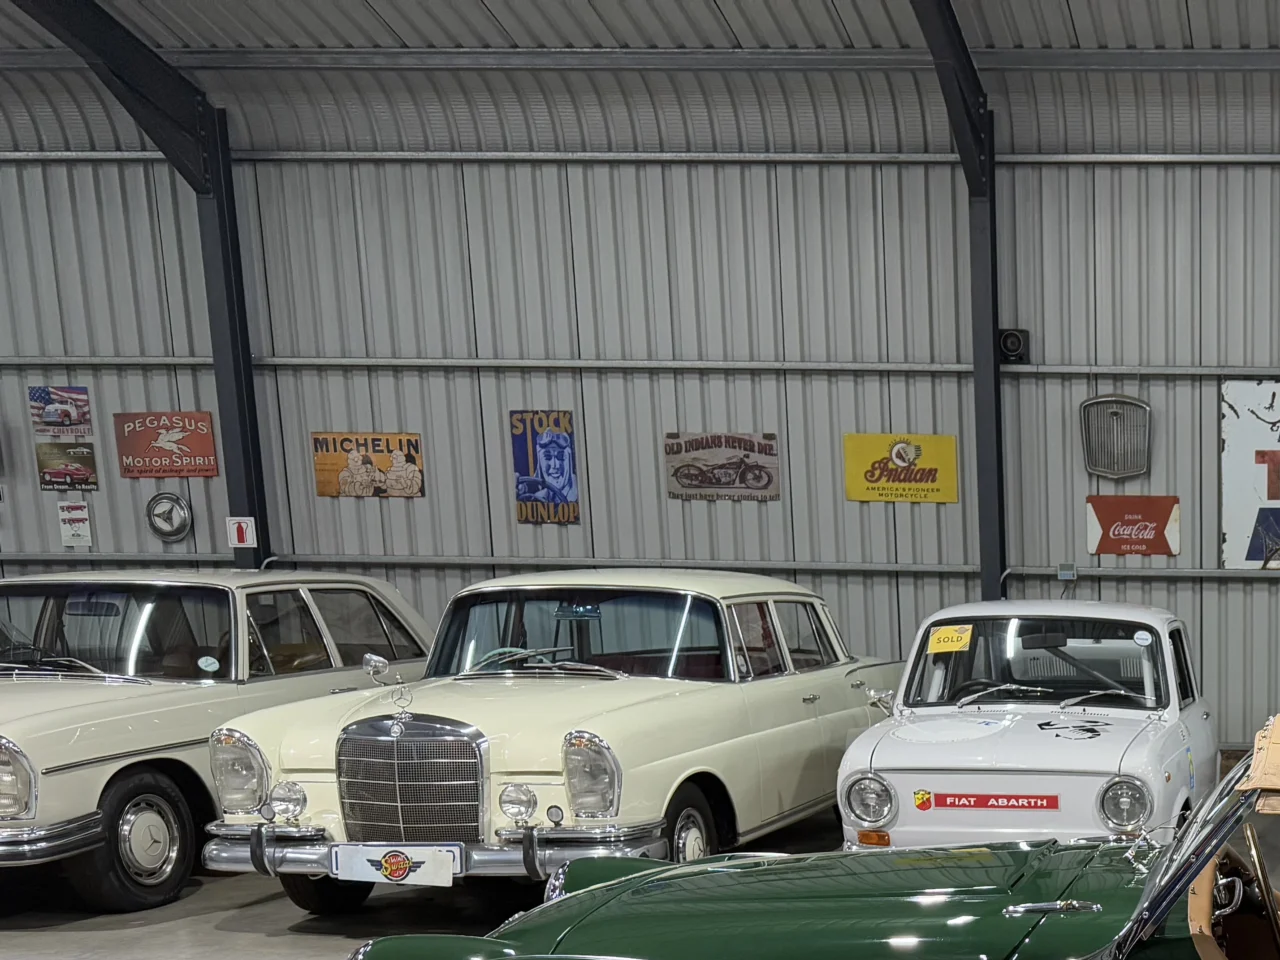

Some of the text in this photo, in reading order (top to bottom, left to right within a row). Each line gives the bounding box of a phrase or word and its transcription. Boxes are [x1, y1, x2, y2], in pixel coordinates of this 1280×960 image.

[123, 415, 207, 436] PEGASUS
[313, 437, 420, 454] MICHELIN
[665, 443, 683, 455] OLD
[684, 434, 723, 453] INDIANS
[724, 434, 755, 454] NEVER
[122, 454, 215, 466] MOTOR SPIRIT
[136, 467, 154, 475] spirit
[864, 456, 938, 484] Indian
[684, 491, 698, 500] just
[516, 501, 580, 522] DUNLOP
[1109, 521, 1157, 539] Coca-Cola
[936, 635, 963, 644] SOLD
[946, 797, 1047, 807] FIAT ABARTH
